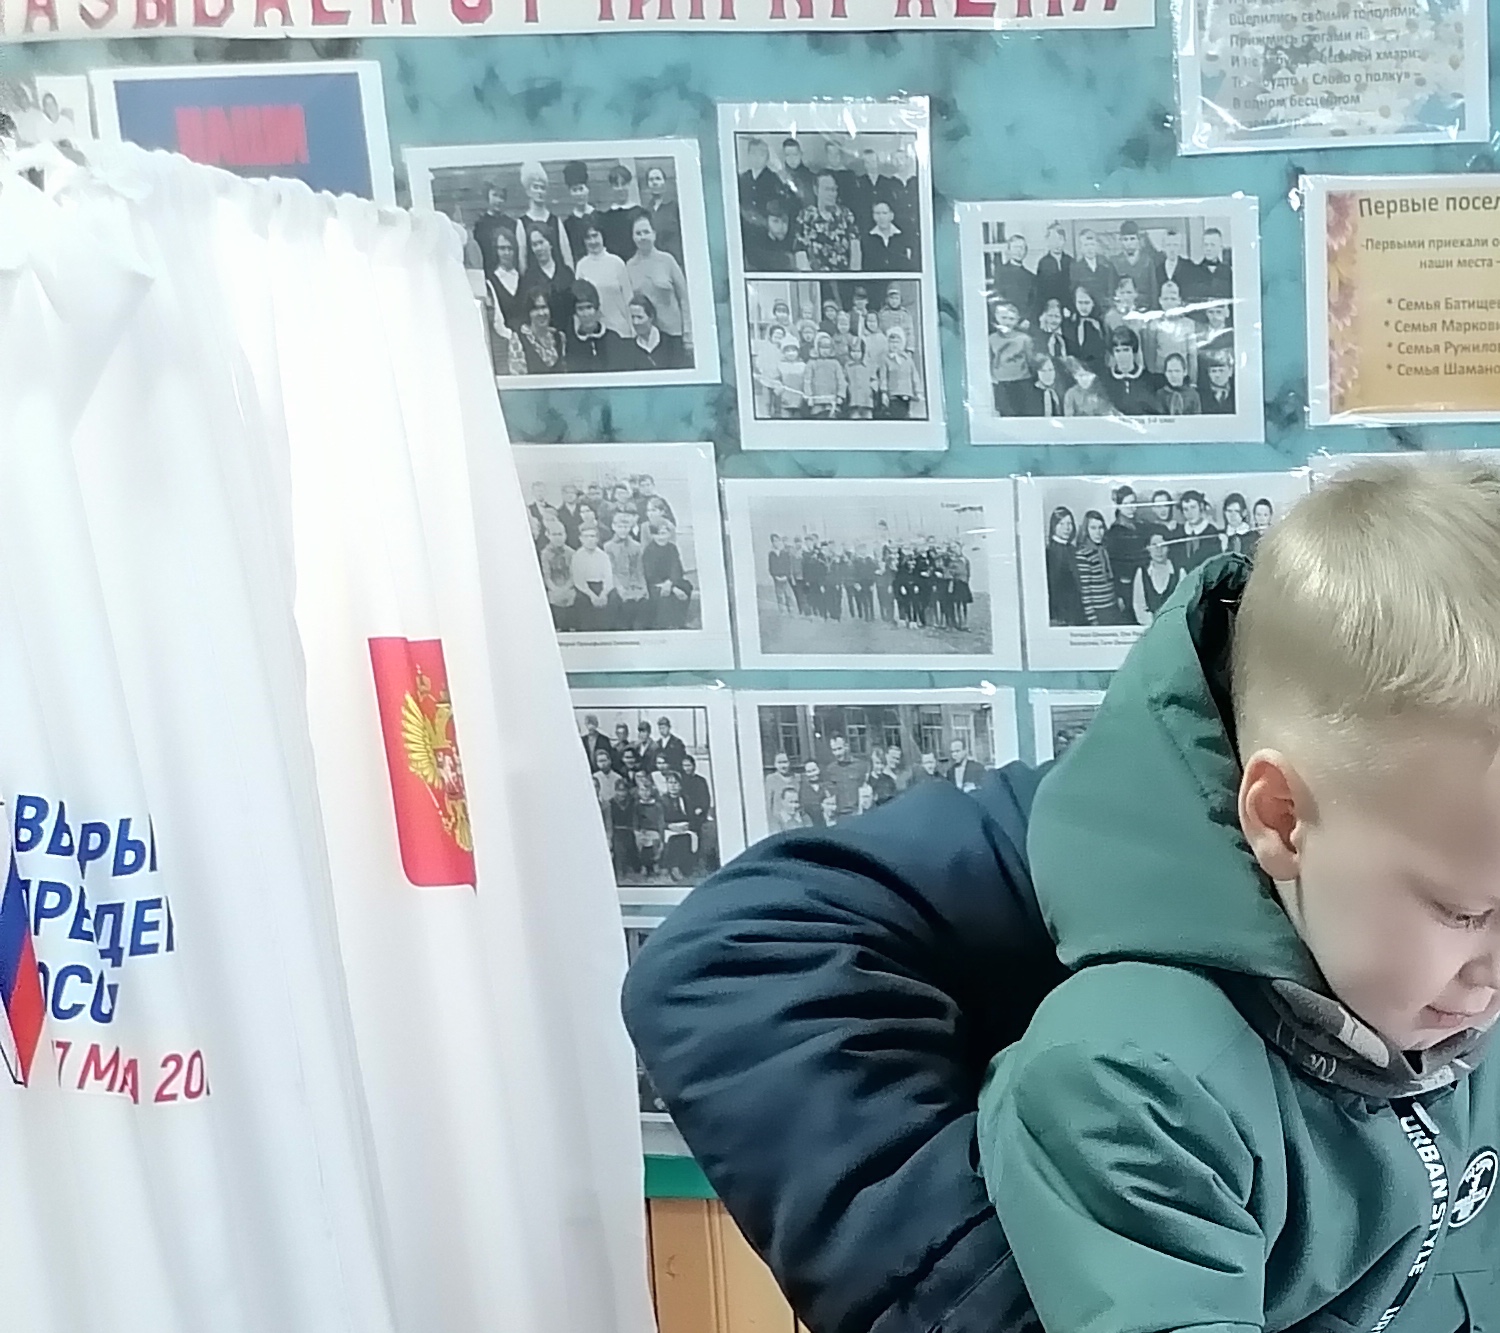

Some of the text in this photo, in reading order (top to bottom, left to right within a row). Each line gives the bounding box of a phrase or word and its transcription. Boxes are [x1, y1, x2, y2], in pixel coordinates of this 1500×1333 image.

[1359, 196, 1439, 219] Первые
[1428, 237, 1489, 252] приехали
[1419, 257, 1493, 269] наши места
[1397, 297, 1441, 311] Семья
[1394, 319, 1438, 333] Семья
[1397, 341, 1441, 355] Семья
[1397, 363, 1440, 376] Семья
[1400, 1115, 1448, 1278] URBAN STYLE
